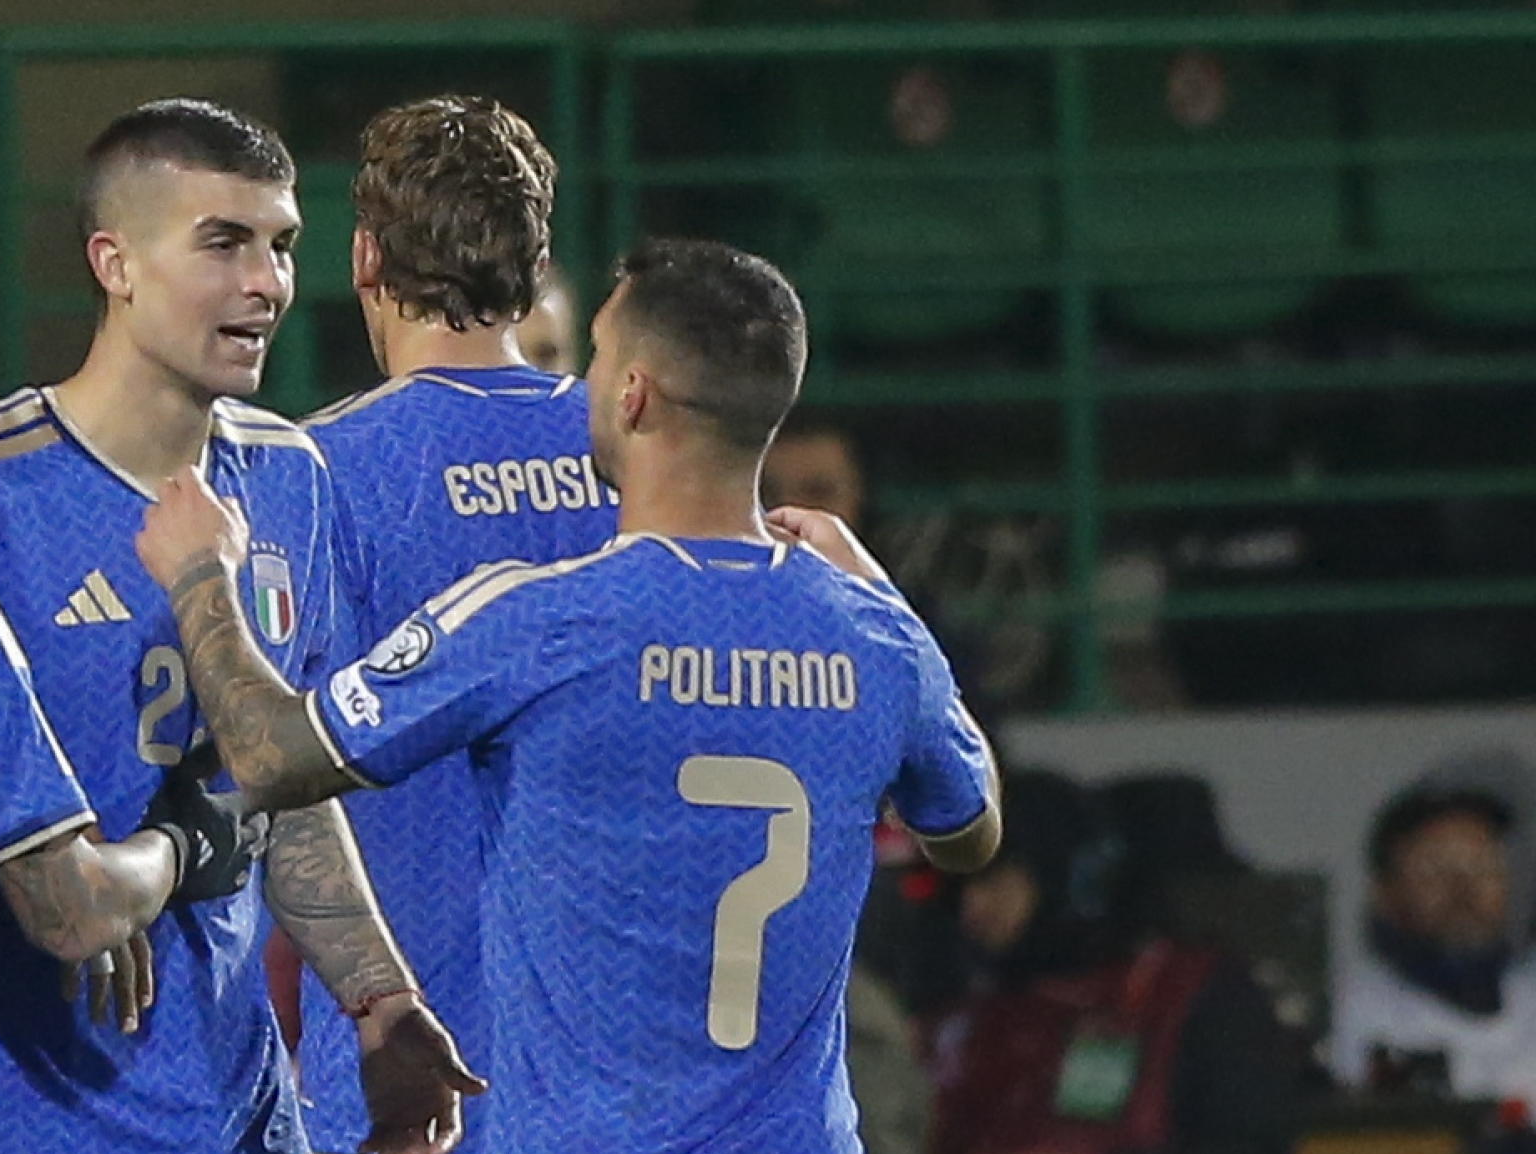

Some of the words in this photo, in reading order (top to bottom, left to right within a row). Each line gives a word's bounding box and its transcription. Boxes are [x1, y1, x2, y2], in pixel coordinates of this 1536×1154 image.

[443, 454, 621, 517] ESPOSI
[137, 645, 206, 766] 2
[639, 643, 857, 711] POLITANO
[676, 754, 810, 1050] 7
